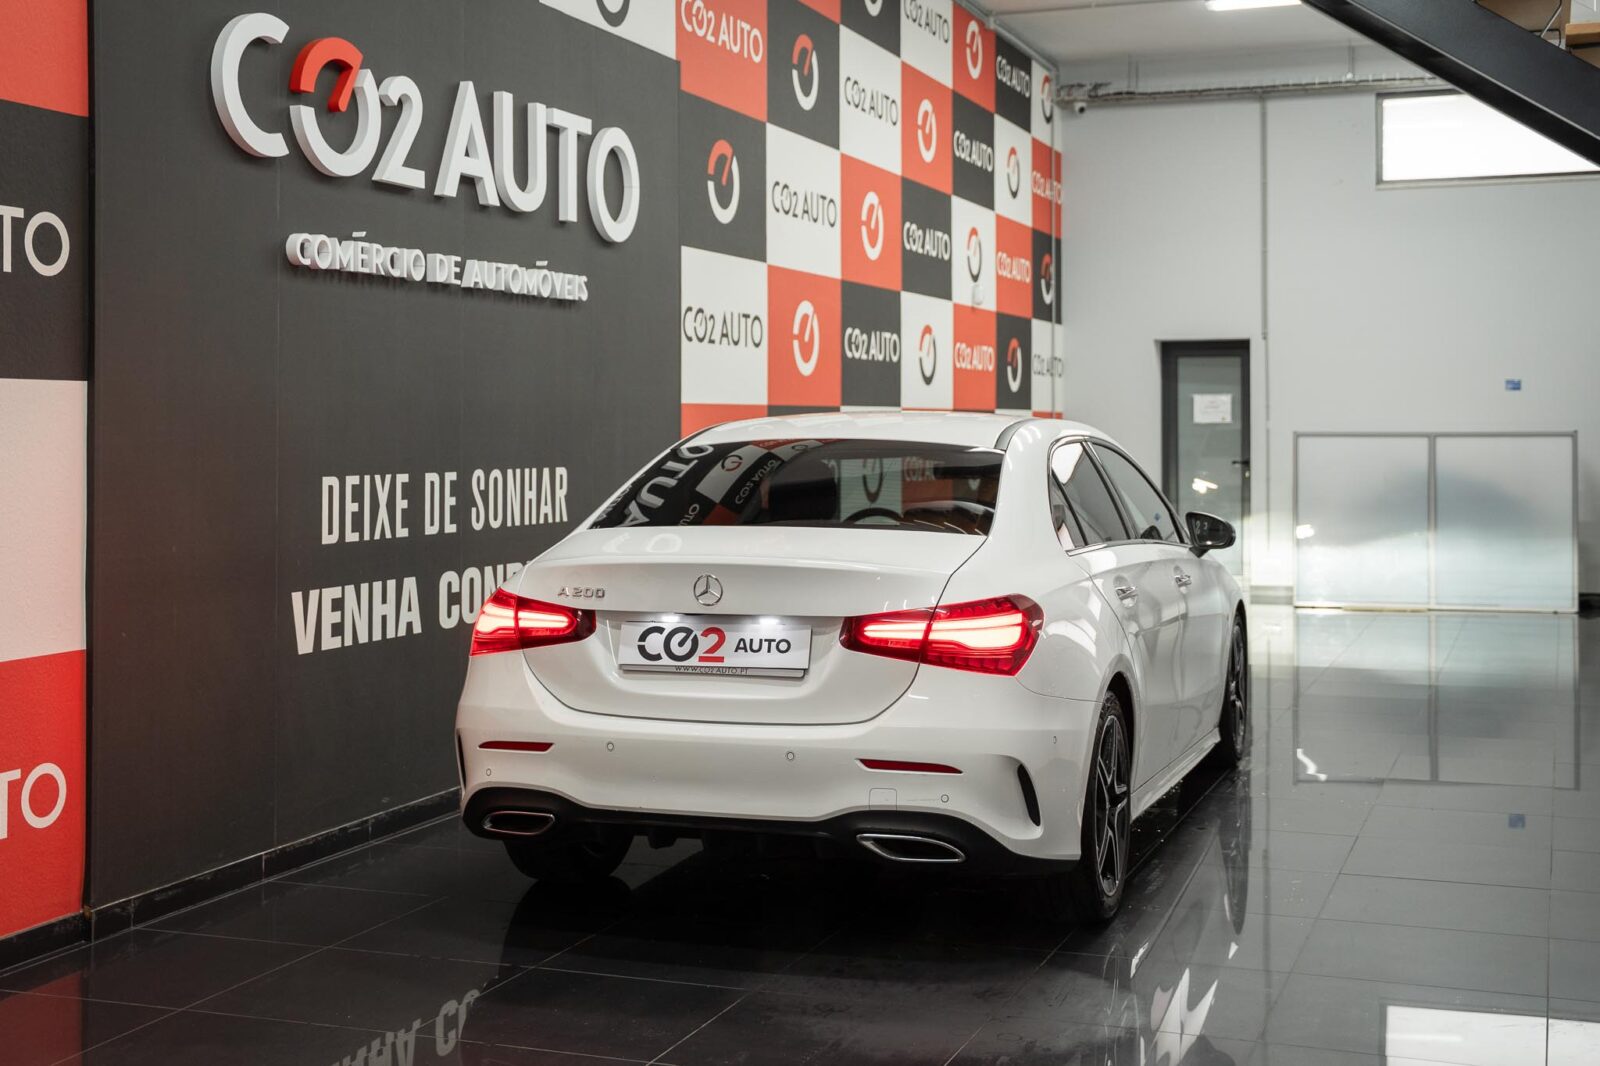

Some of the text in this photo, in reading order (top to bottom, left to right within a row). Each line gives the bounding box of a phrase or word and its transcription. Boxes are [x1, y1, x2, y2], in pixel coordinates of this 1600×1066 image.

[681, 0, 763, 64] CO2 AUTO
[924, 6, 950, 44] AUTO
[844, 76, 899, 126] CO2 AUTO
[1010, 65, 1031, 98] AUTO
[211, 12, 640, 243] CO2 AUTO
[953, 130, 994, 173] CO2 AUTO
[771, 180, 837, 228] CO2 AUTO
[903, 221, 951, 261] CO2 AUTO
[286, 231, 588, 301] COMÉRCIO DE AUTOMÓVEIS
[1011, 255, 1032, 283] AUTO
[682, 306, 763, 348] CO2 AUTO
[844, 326, 900, 363] CO2 AUTO
[971, 344, 995, 372] AUTO
[321, 473, 410, 545] DEIXE
[424, 471, 458, 536] DE
[470, 466, 569, 531] SONHAR
[557, 586, 606, 599] A 200
[291, 576, 423, 656] VENHA
[637, 625, 792, 663] CO2 AUTO
